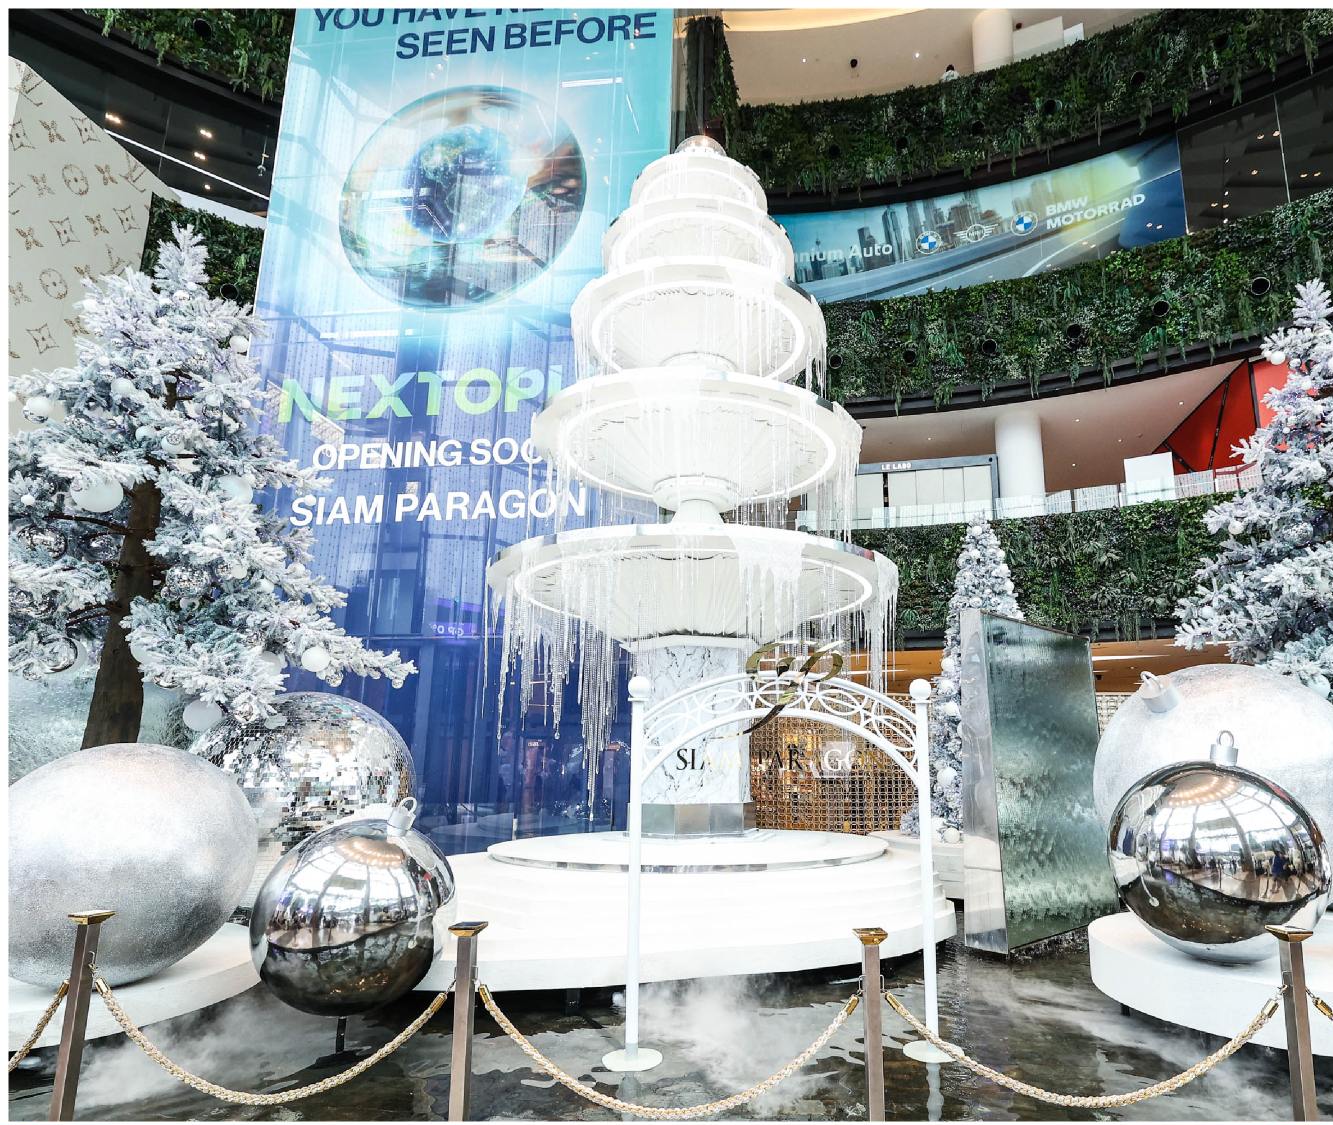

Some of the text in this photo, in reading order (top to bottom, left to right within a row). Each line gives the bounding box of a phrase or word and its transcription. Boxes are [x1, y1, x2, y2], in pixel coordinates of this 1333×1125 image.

[313, 8, 385, 31] YOU
[395, 12, 657, 60] SEEN BEFORE
[1046, 196, 1088, 216] BMW
[1046, 193, 1146, 230] MOTORRAD
[848, 243, 893, 259] Auto
[278, 365, 563, 423] NEXTOPI
[312, 436, 545, 470] OPENING SOO
[289, 487, 587, 527] SIAM PARAGON
[676, 749, 742, 770] SIAM
